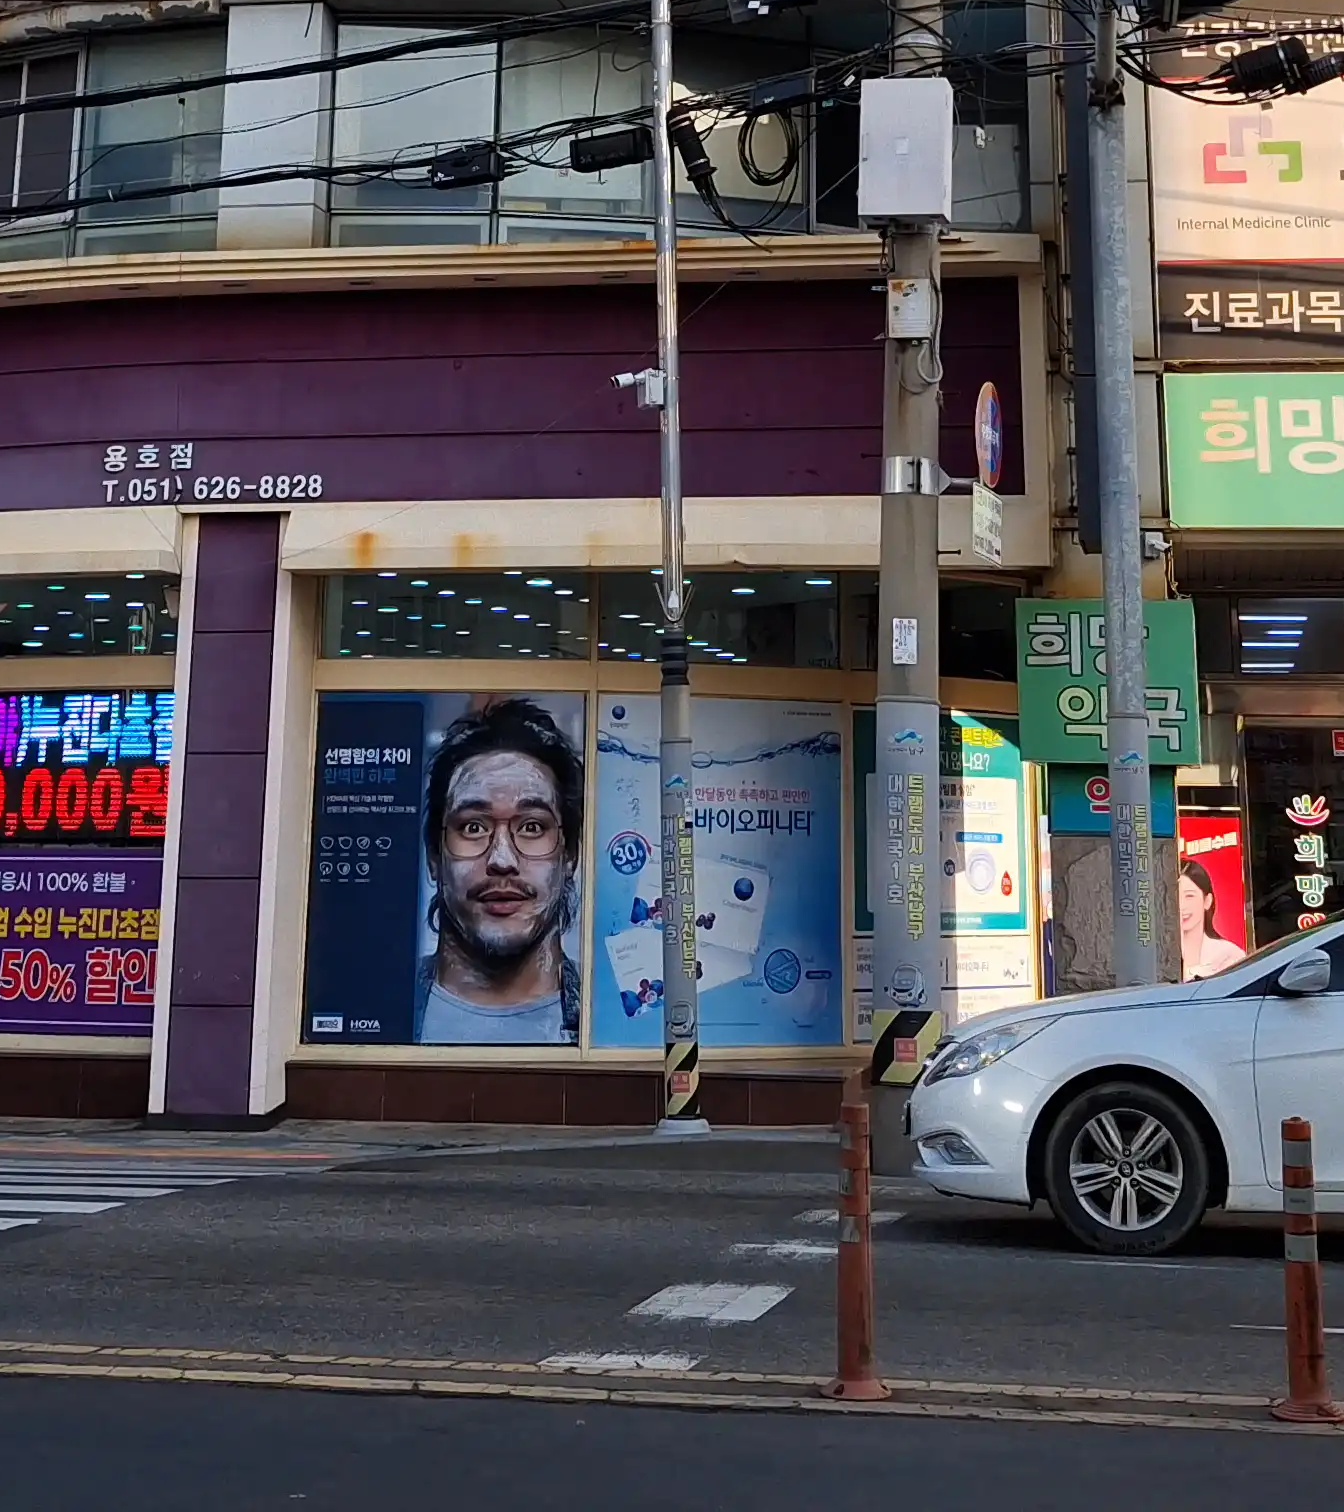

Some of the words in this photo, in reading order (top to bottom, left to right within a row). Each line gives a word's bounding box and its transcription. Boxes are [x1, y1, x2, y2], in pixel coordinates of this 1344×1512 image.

[1176, 215, 1227, 231] Internal
[1231, 215, 1292, 231] Medicine
[1295, 214, 1332, 230] Clinic
[102, 443, 194, 473] 용호점
[191, 474, 323, 501] 626-8828
[324, 747, 380, 765] 선명함의
[382, 747, 411, 765] 차이
[694, 807, 813, 837] 바이오피니티
[37, 872, 89, 893] 100%
[92, 871, 127, 893] 환불
[13, 906, 53, 939] 수입
[84, 946, 158, 1006] 할인
[350, 1019, 381, 1029] HOYA
